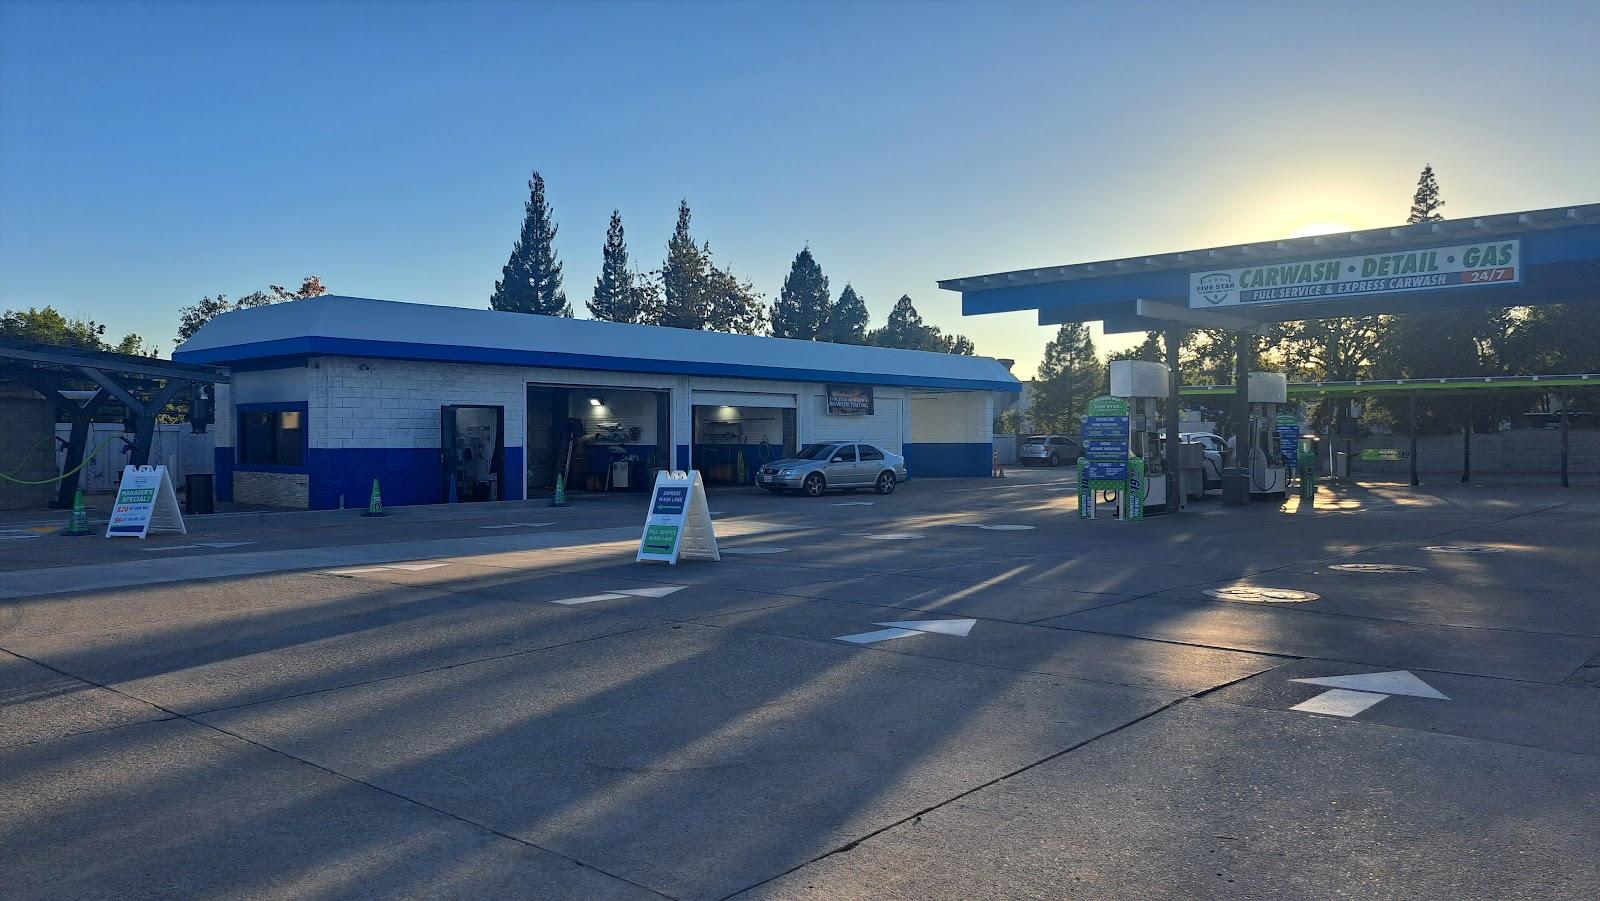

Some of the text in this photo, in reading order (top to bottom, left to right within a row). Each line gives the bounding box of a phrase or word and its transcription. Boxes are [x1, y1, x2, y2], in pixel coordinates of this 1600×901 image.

[1239, 244, 1513, 288] CARWASH DETAIL GAS
[1471, 269, 1505, 282] 24/7
[1196, 284, 1213, 292] FIVE
[1215, 282, 1235, 290] STAR
[1253, 273, 1447, 300] FULL SERVICE & EXPRESS CARWASH
[121, 495, 150, 503] SPECIAL!
